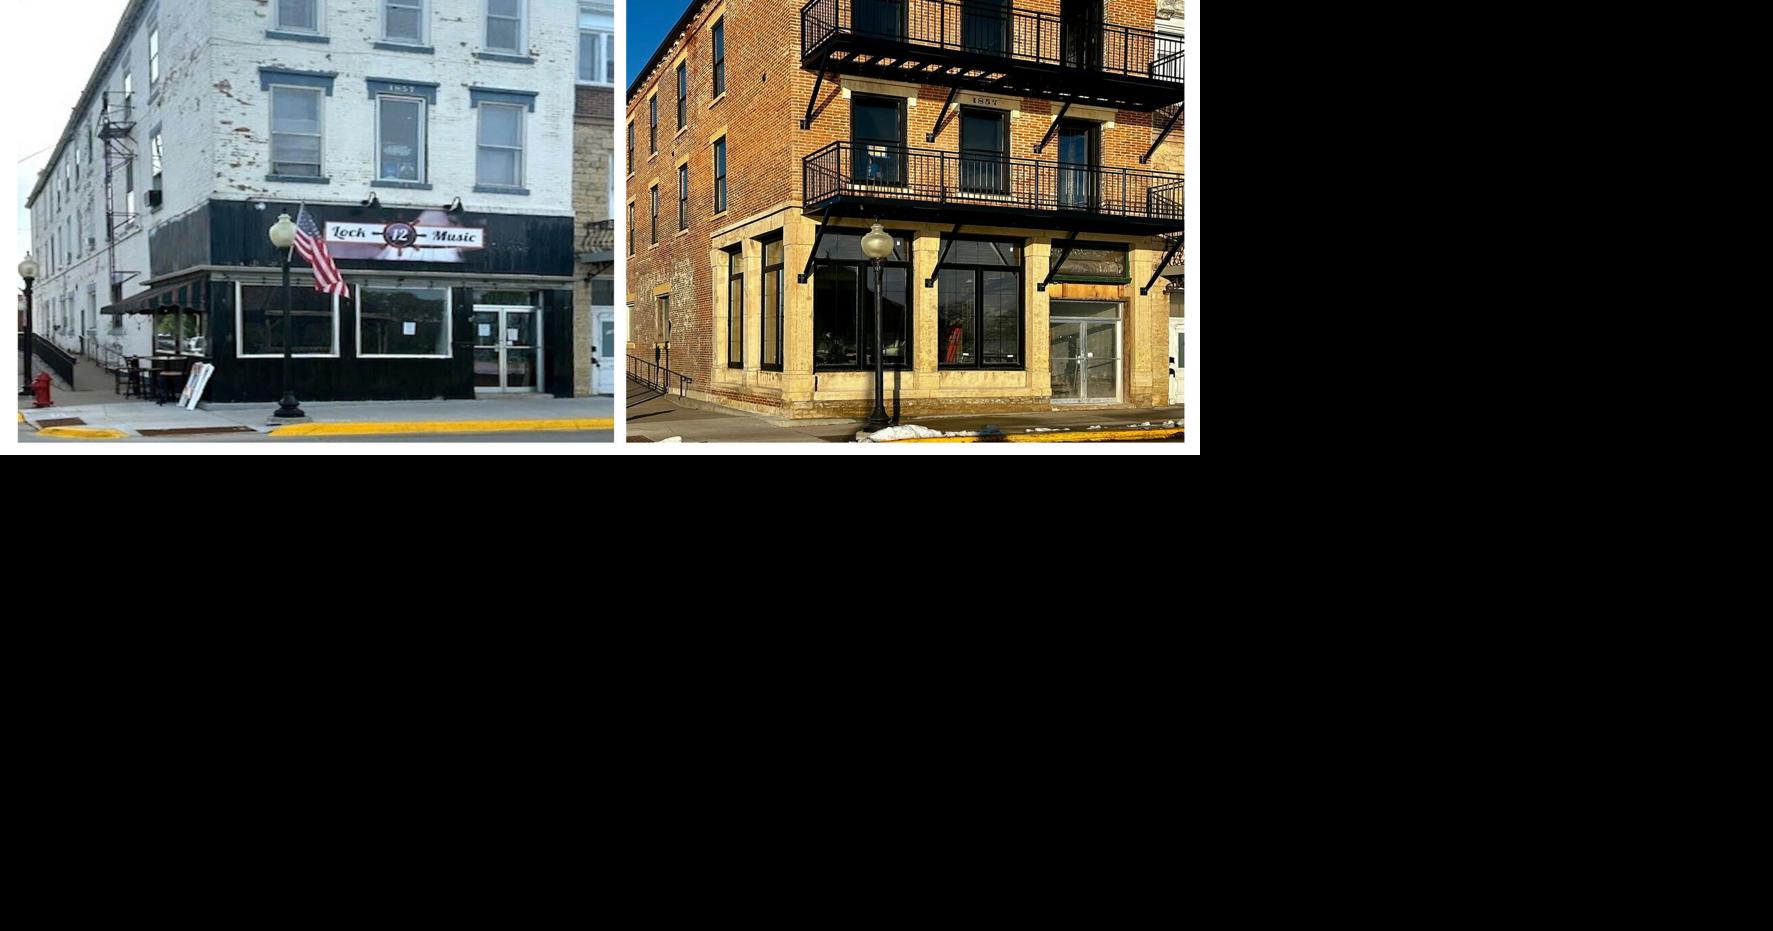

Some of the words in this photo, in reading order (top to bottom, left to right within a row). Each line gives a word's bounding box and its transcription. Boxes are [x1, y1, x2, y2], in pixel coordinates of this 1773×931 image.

[973, 97, 997, 106] 1857
[332, 225, 366, 239] Lock
[391, 228, 409, 241] 12
[432, 230, 477, 243] Music
